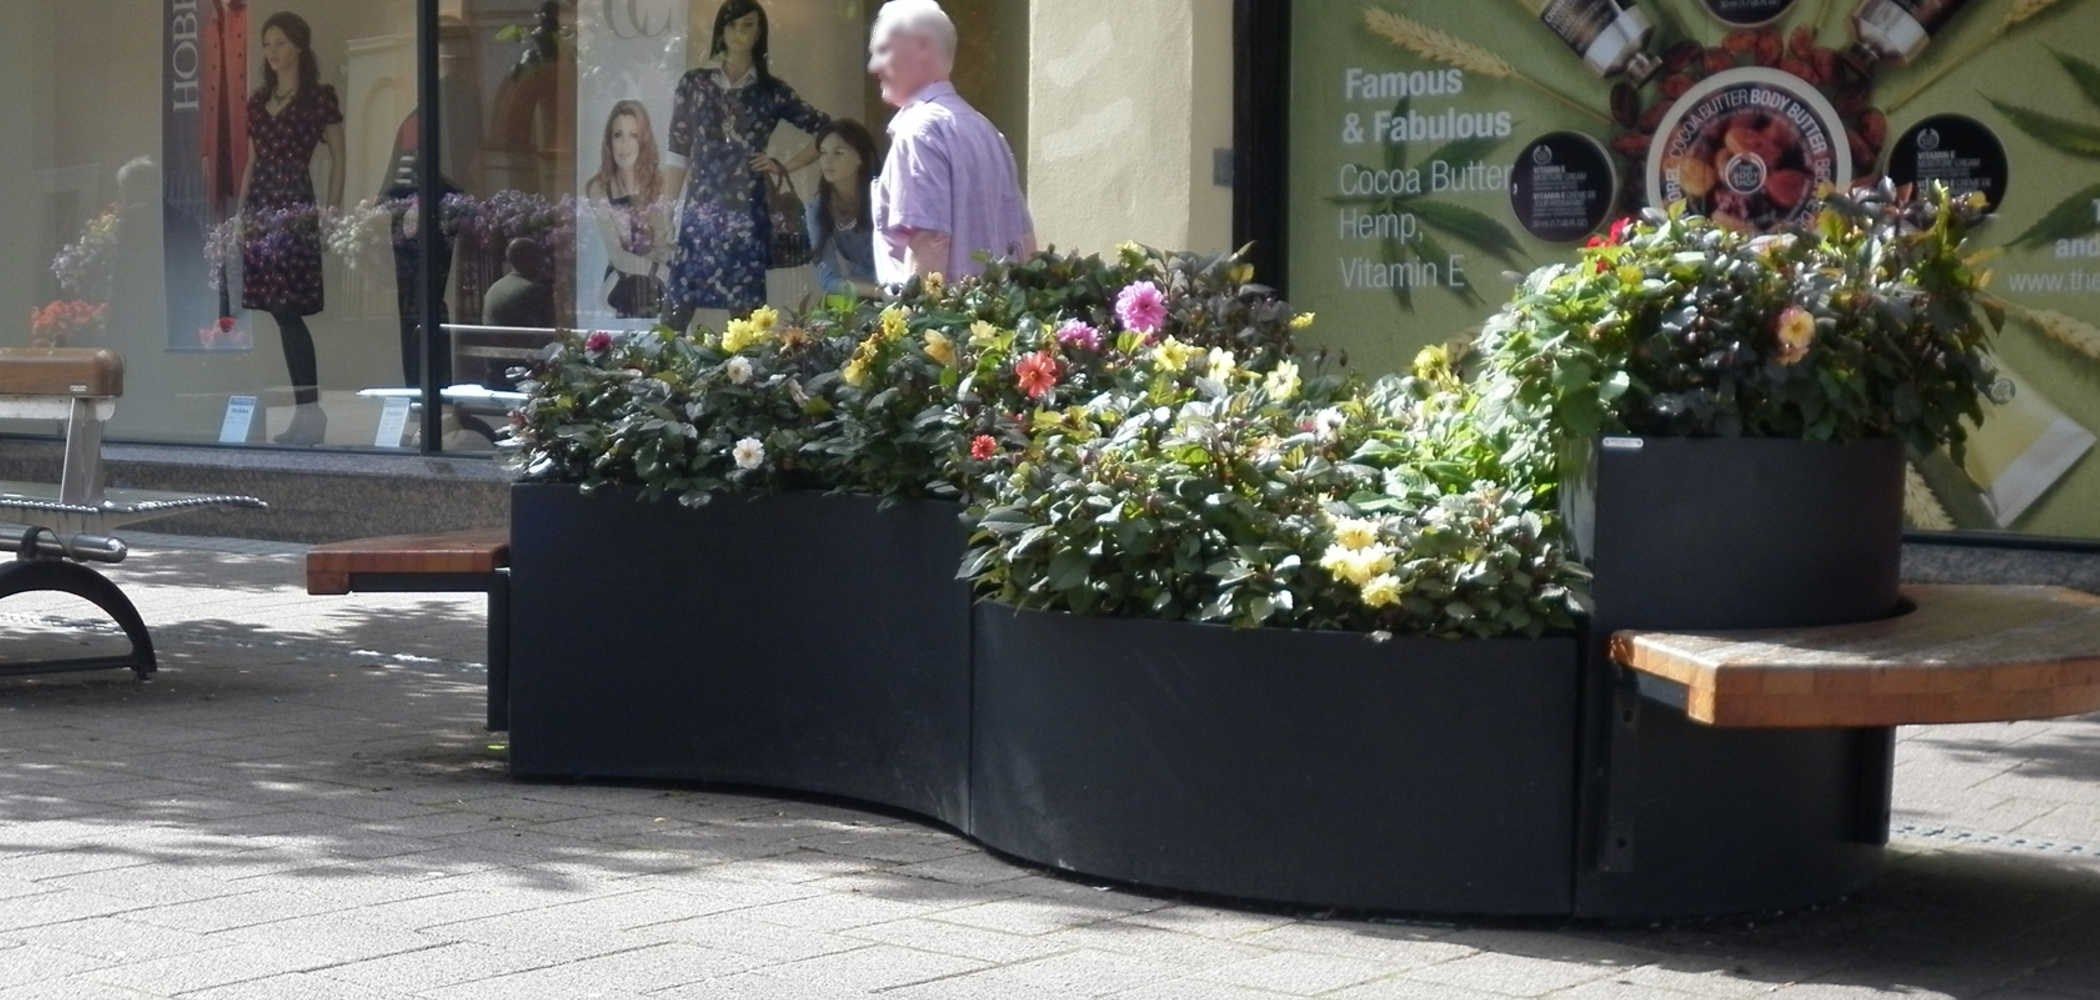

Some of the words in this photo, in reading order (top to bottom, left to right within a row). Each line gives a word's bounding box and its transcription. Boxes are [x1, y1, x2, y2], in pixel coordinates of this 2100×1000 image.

[1345, 67, 1464, 99] Famous
[1341, 112, 1364, 143] &
[1373, 107, 1512, 143] Fabulous
[1668, 113, 1701, 159] COCOA
[1699, 88, 1750, 120] BUTTER
[1750, 88, 1791, 110] BODY
[1787, 102, 1828, 155] BUTTER
[1340, 163, 1422, 196] Cocoa
[1431, 160, 1519, 195] Butter,
[1339, 208, 1423, 245] Hemp,
[2056, 232, 2100, 257] and
[1339, 256, 1438, 288] Vitamin
[1449, 254, 1465, 287] E
